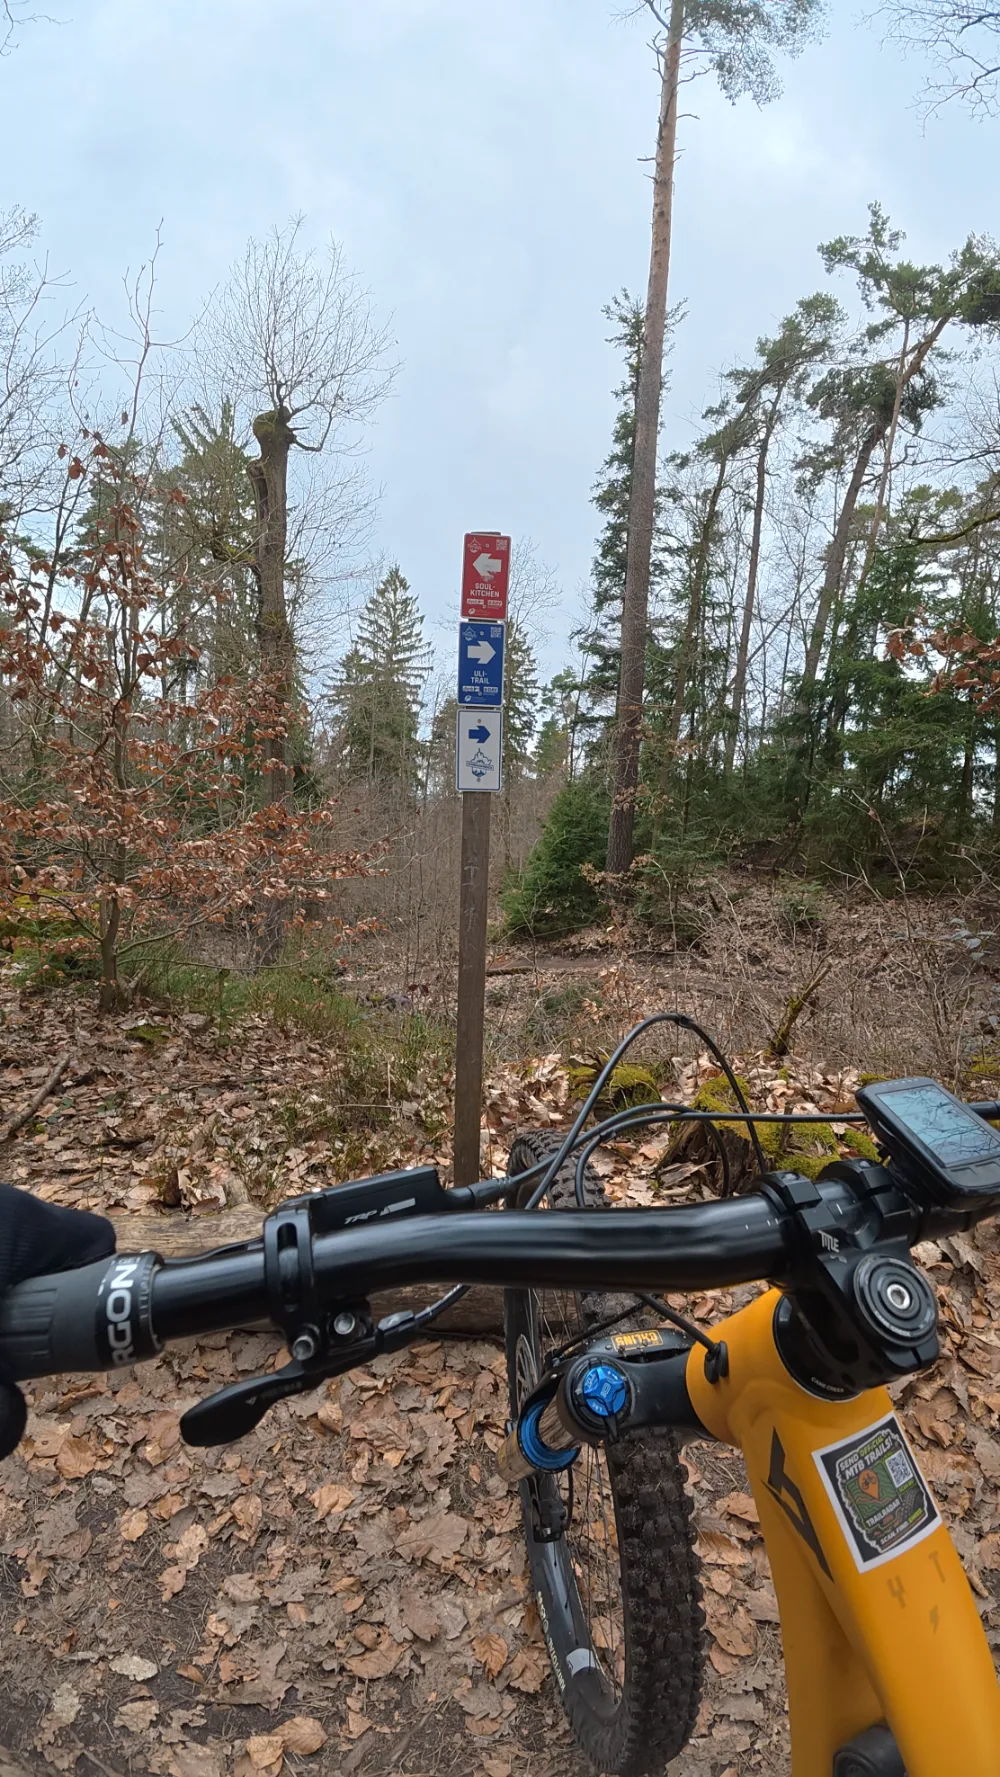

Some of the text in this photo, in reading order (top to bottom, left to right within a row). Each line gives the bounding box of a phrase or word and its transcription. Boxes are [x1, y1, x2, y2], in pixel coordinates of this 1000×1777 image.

[344, 1210, 378, 1224] TRP
[106, 1264, 138, 1364] RGON
[840, 1454, 859, 1470] SEND
[845, 1460, 865, 1480] MTB
[864, 1436, 892, 1465] TRAILS!
[866, 1498, 900, 1527] TRAILRADAR
